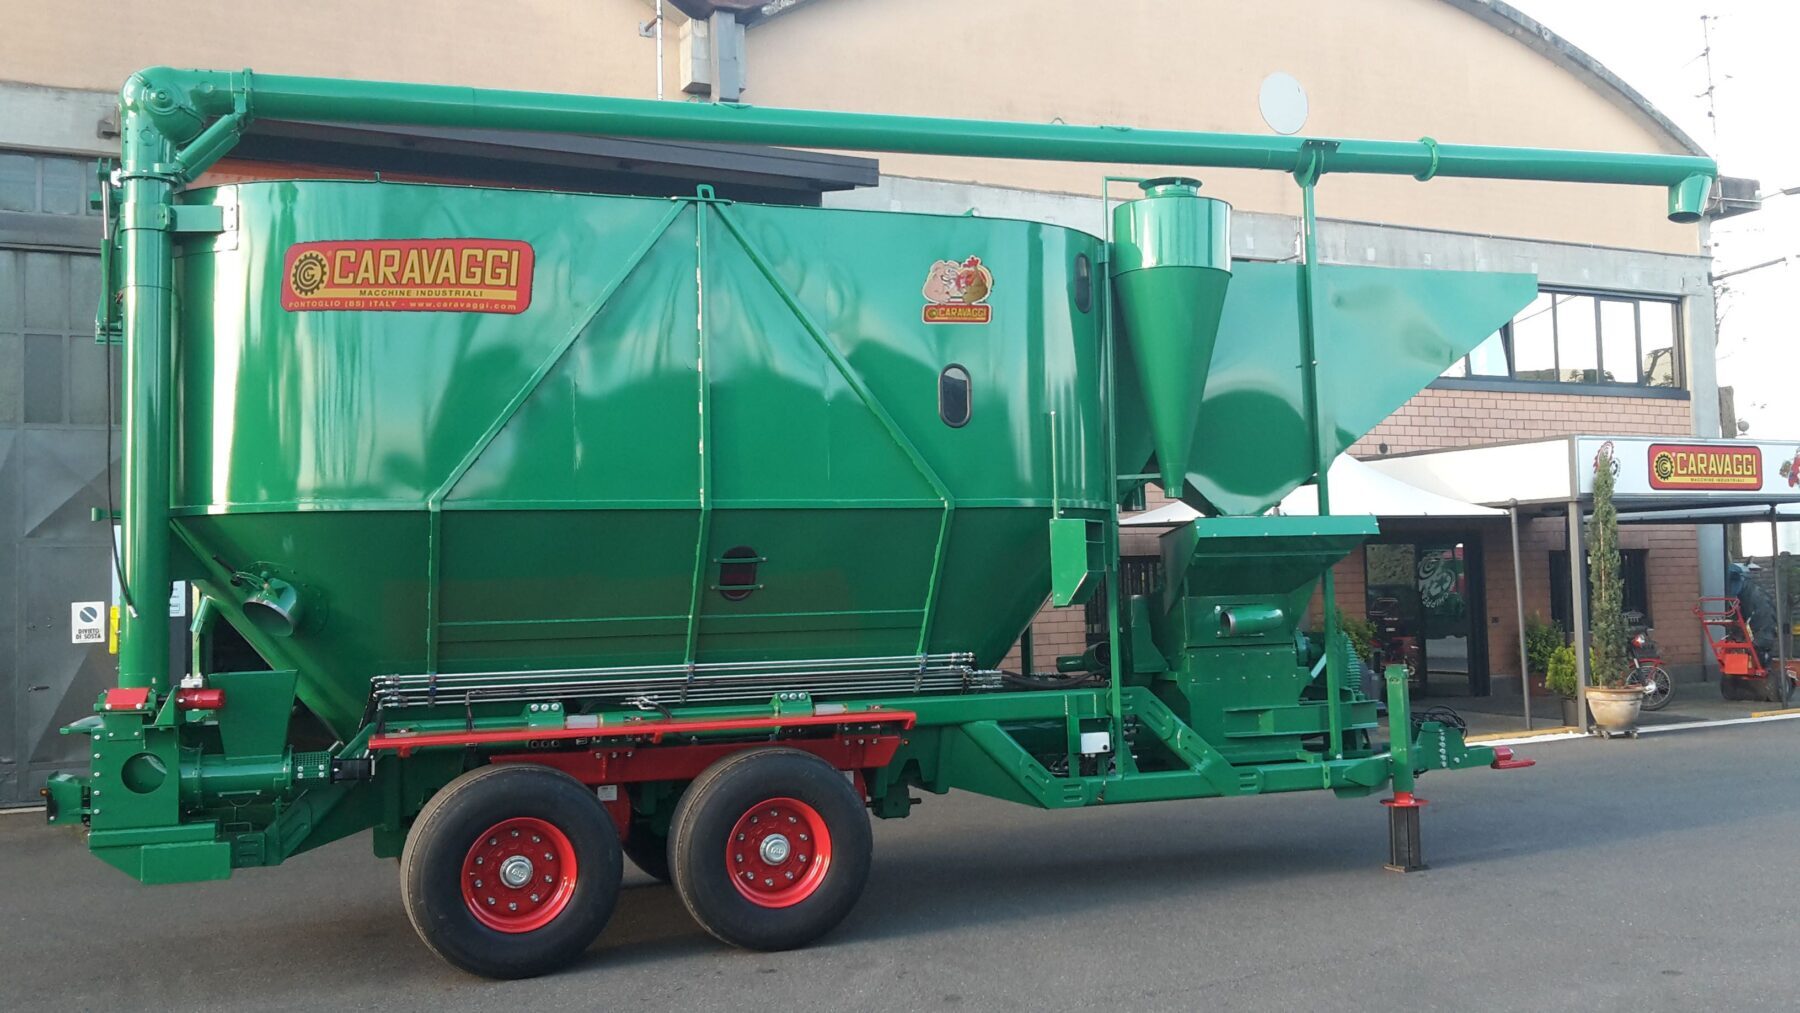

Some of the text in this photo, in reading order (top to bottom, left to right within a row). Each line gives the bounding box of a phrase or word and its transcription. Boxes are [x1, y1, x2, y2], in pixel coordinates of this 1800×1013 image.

[333, 248, 519, 287] CARAVAGGI
[359, 289, 484, 297] MACCHINE INDUSTRIALI
[288, 300, 341, 308] PONTOGLIO
[344, 300, 365, 308] (BS)
[409, 301, 517, 310] www.caravaggi.com
[938, 307, 987, 317] CARAVAGGI
[1676, 452, 1757, 476] CARAVAGGI
